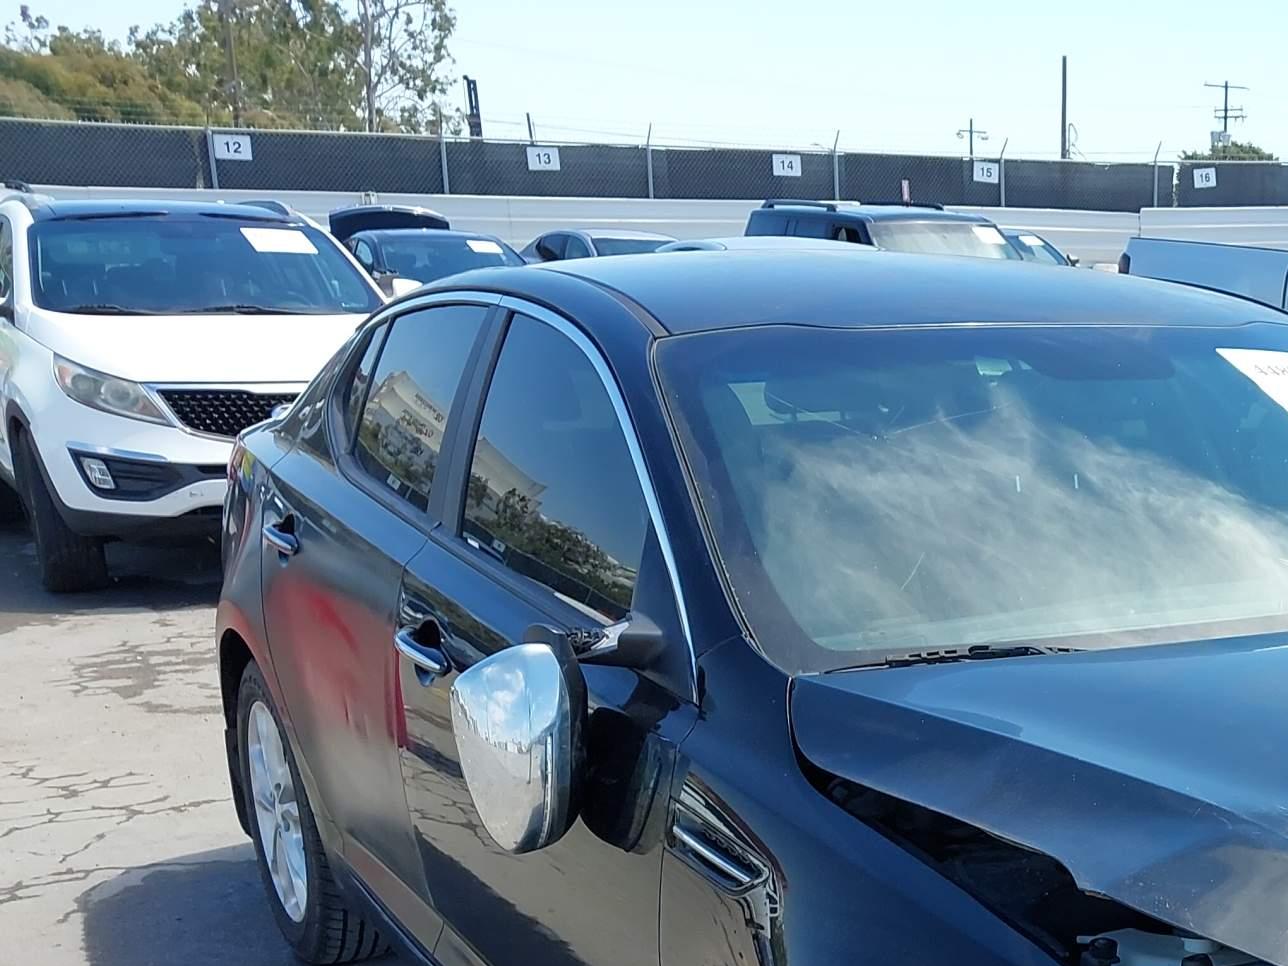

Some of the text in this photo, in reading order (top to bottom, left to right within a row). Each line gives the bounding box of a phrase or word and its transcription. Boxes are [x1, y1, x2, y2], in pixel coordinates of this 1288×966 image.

[224, 141, 242, 154] 12
[536, 152, 552, 165] 13
[780, 160, 793, 170] 14
[980, 167, 993, 178] 15
[1200, 172, 1211, 183] 16
